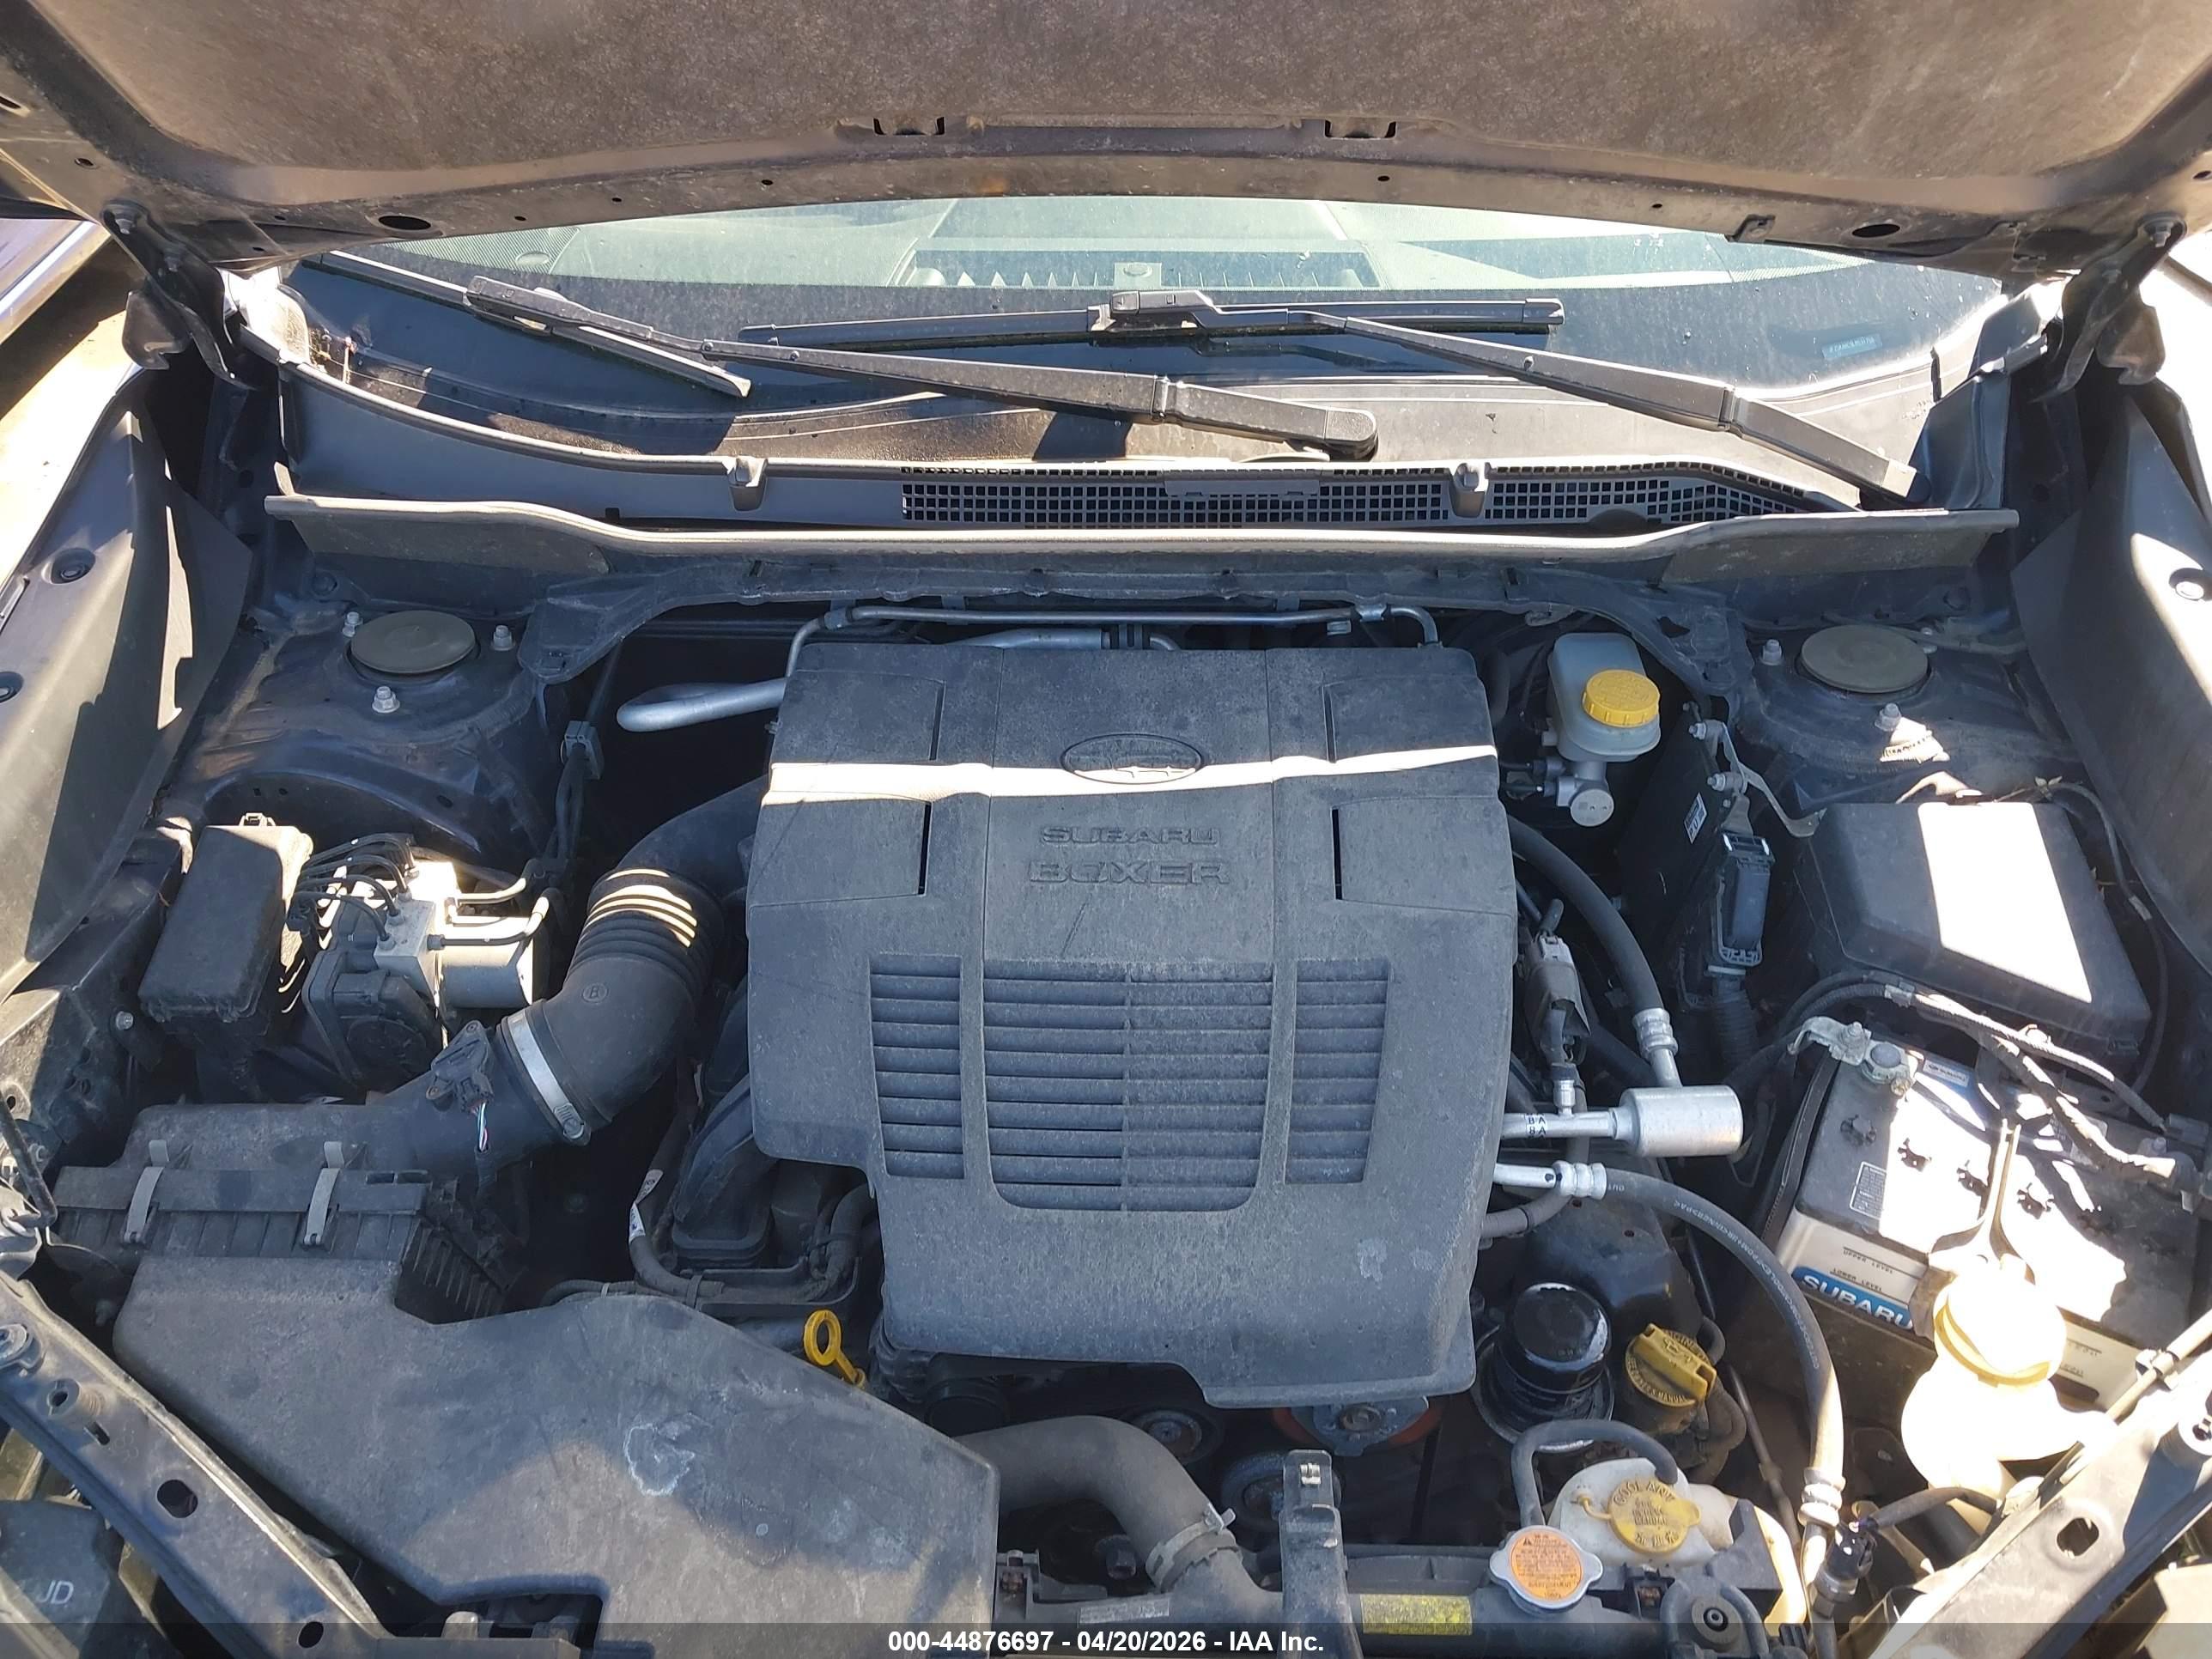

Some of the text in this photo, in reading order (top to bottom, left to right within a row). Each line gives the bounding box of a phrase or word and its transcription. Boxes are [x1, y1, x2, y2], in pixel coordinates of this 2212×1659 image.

[1041, 826, 1219, 846] SUBARU
[1028, 859, 1231, 885] BOXER
[1842, 1249, 1868, 1263] UPPER
[1832, 1267, 1857, 1280] LOWER
[1801, 1274, 1914, 1331] SUBARU
